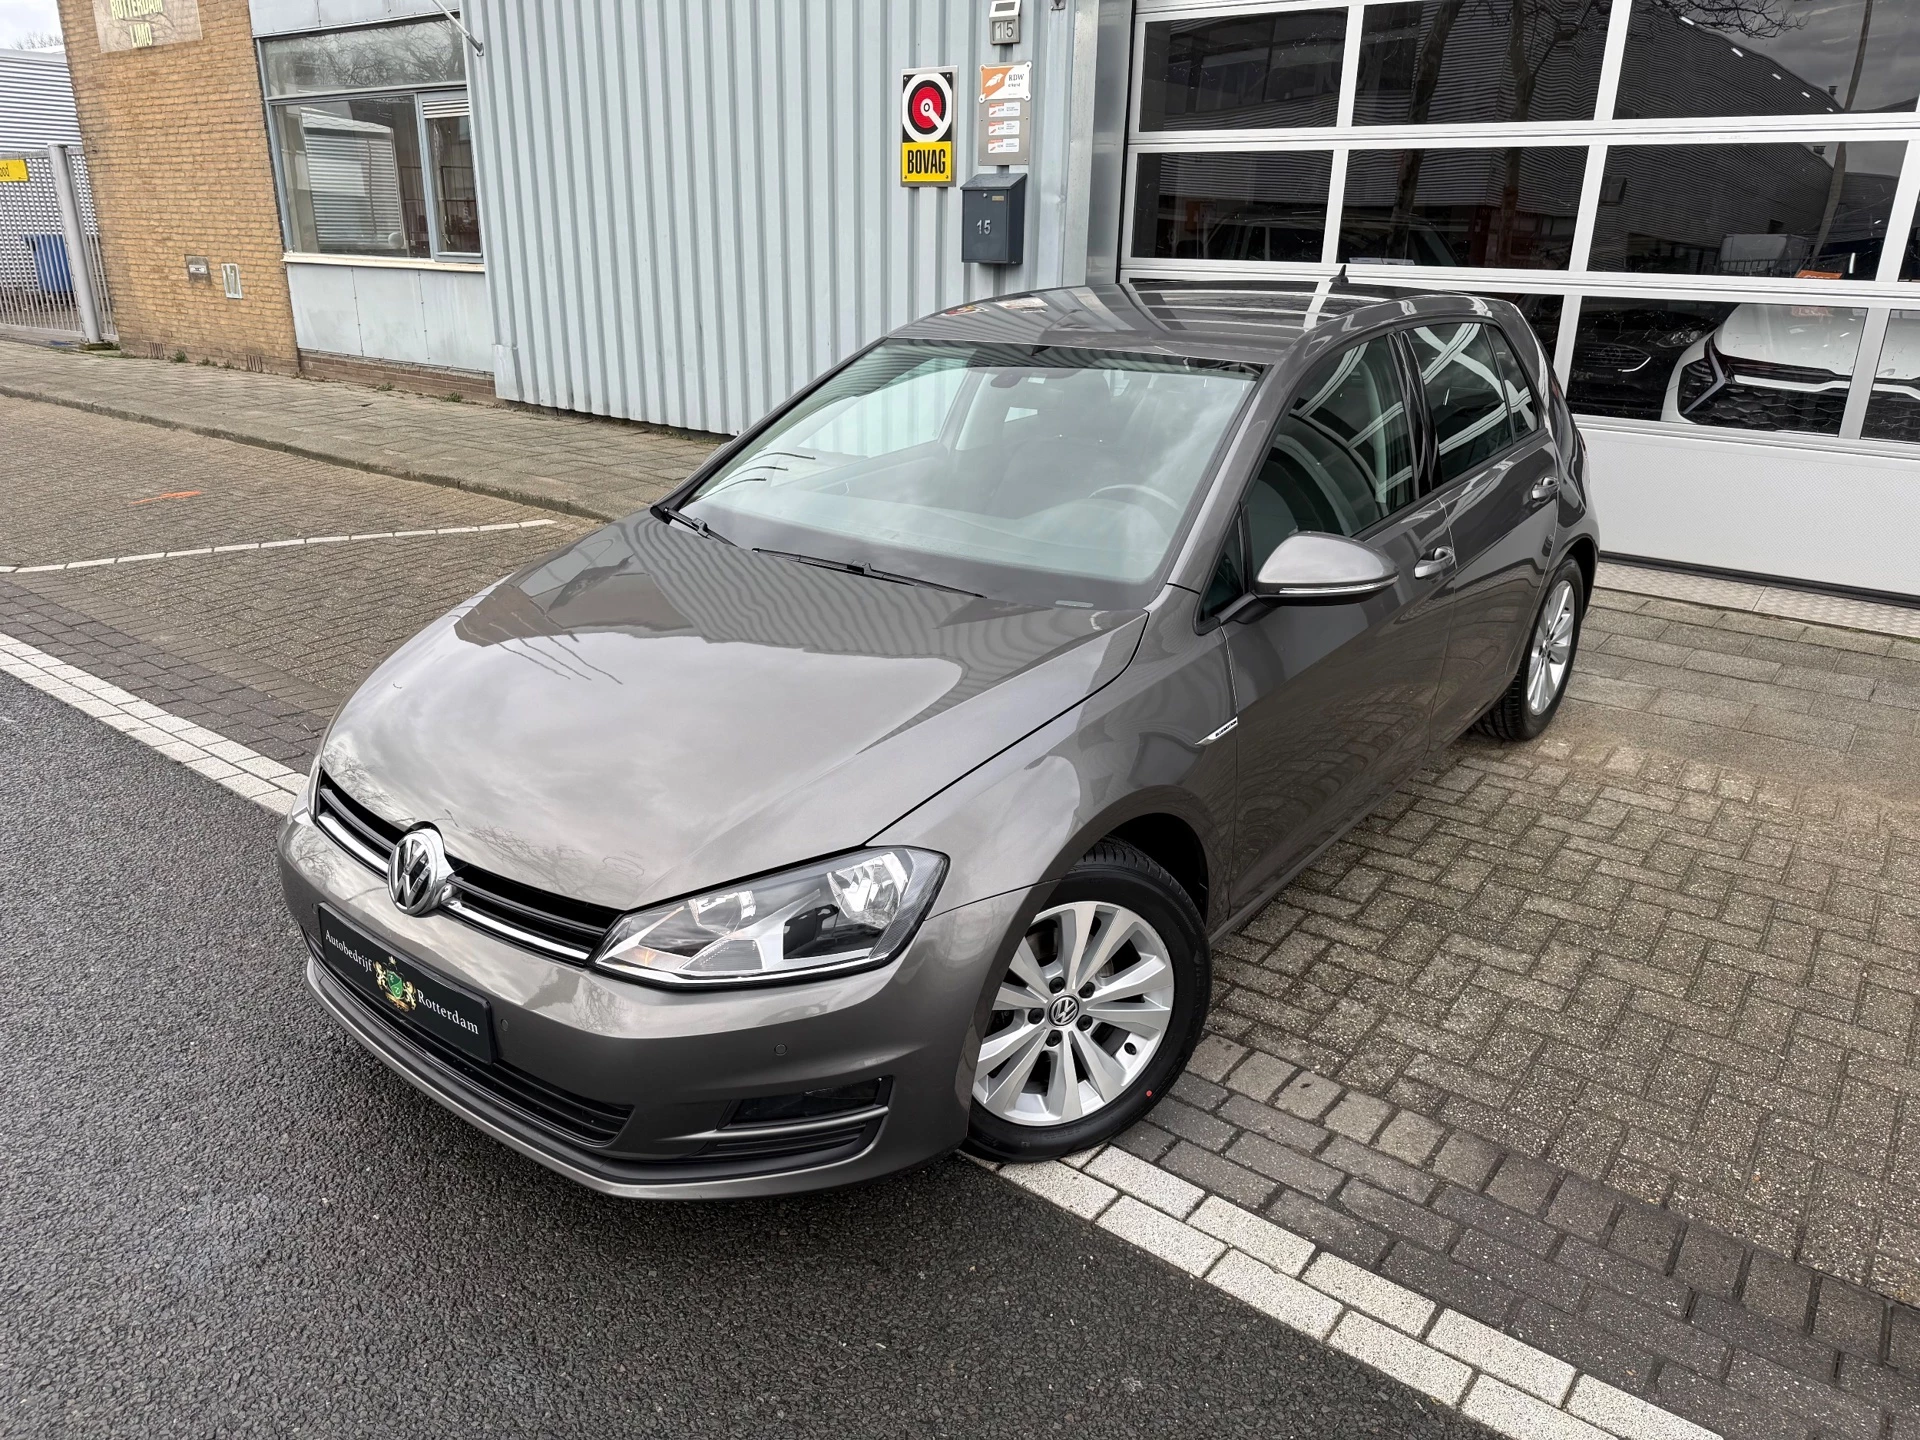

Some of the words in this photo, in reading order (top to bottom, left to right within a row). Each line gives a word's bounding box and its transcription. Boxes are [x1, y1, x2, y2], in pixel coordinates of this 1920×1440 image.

[129, 23, 153, 48] LIMO
[996, 21, 1014, 38] 15
[907, 148, 946, 174] BOVAG
[976, 219, 991, 235] 15
[325, 929, 372, 973] Autobedrijf
[416, 989, 479, 1035] Rotterdam
